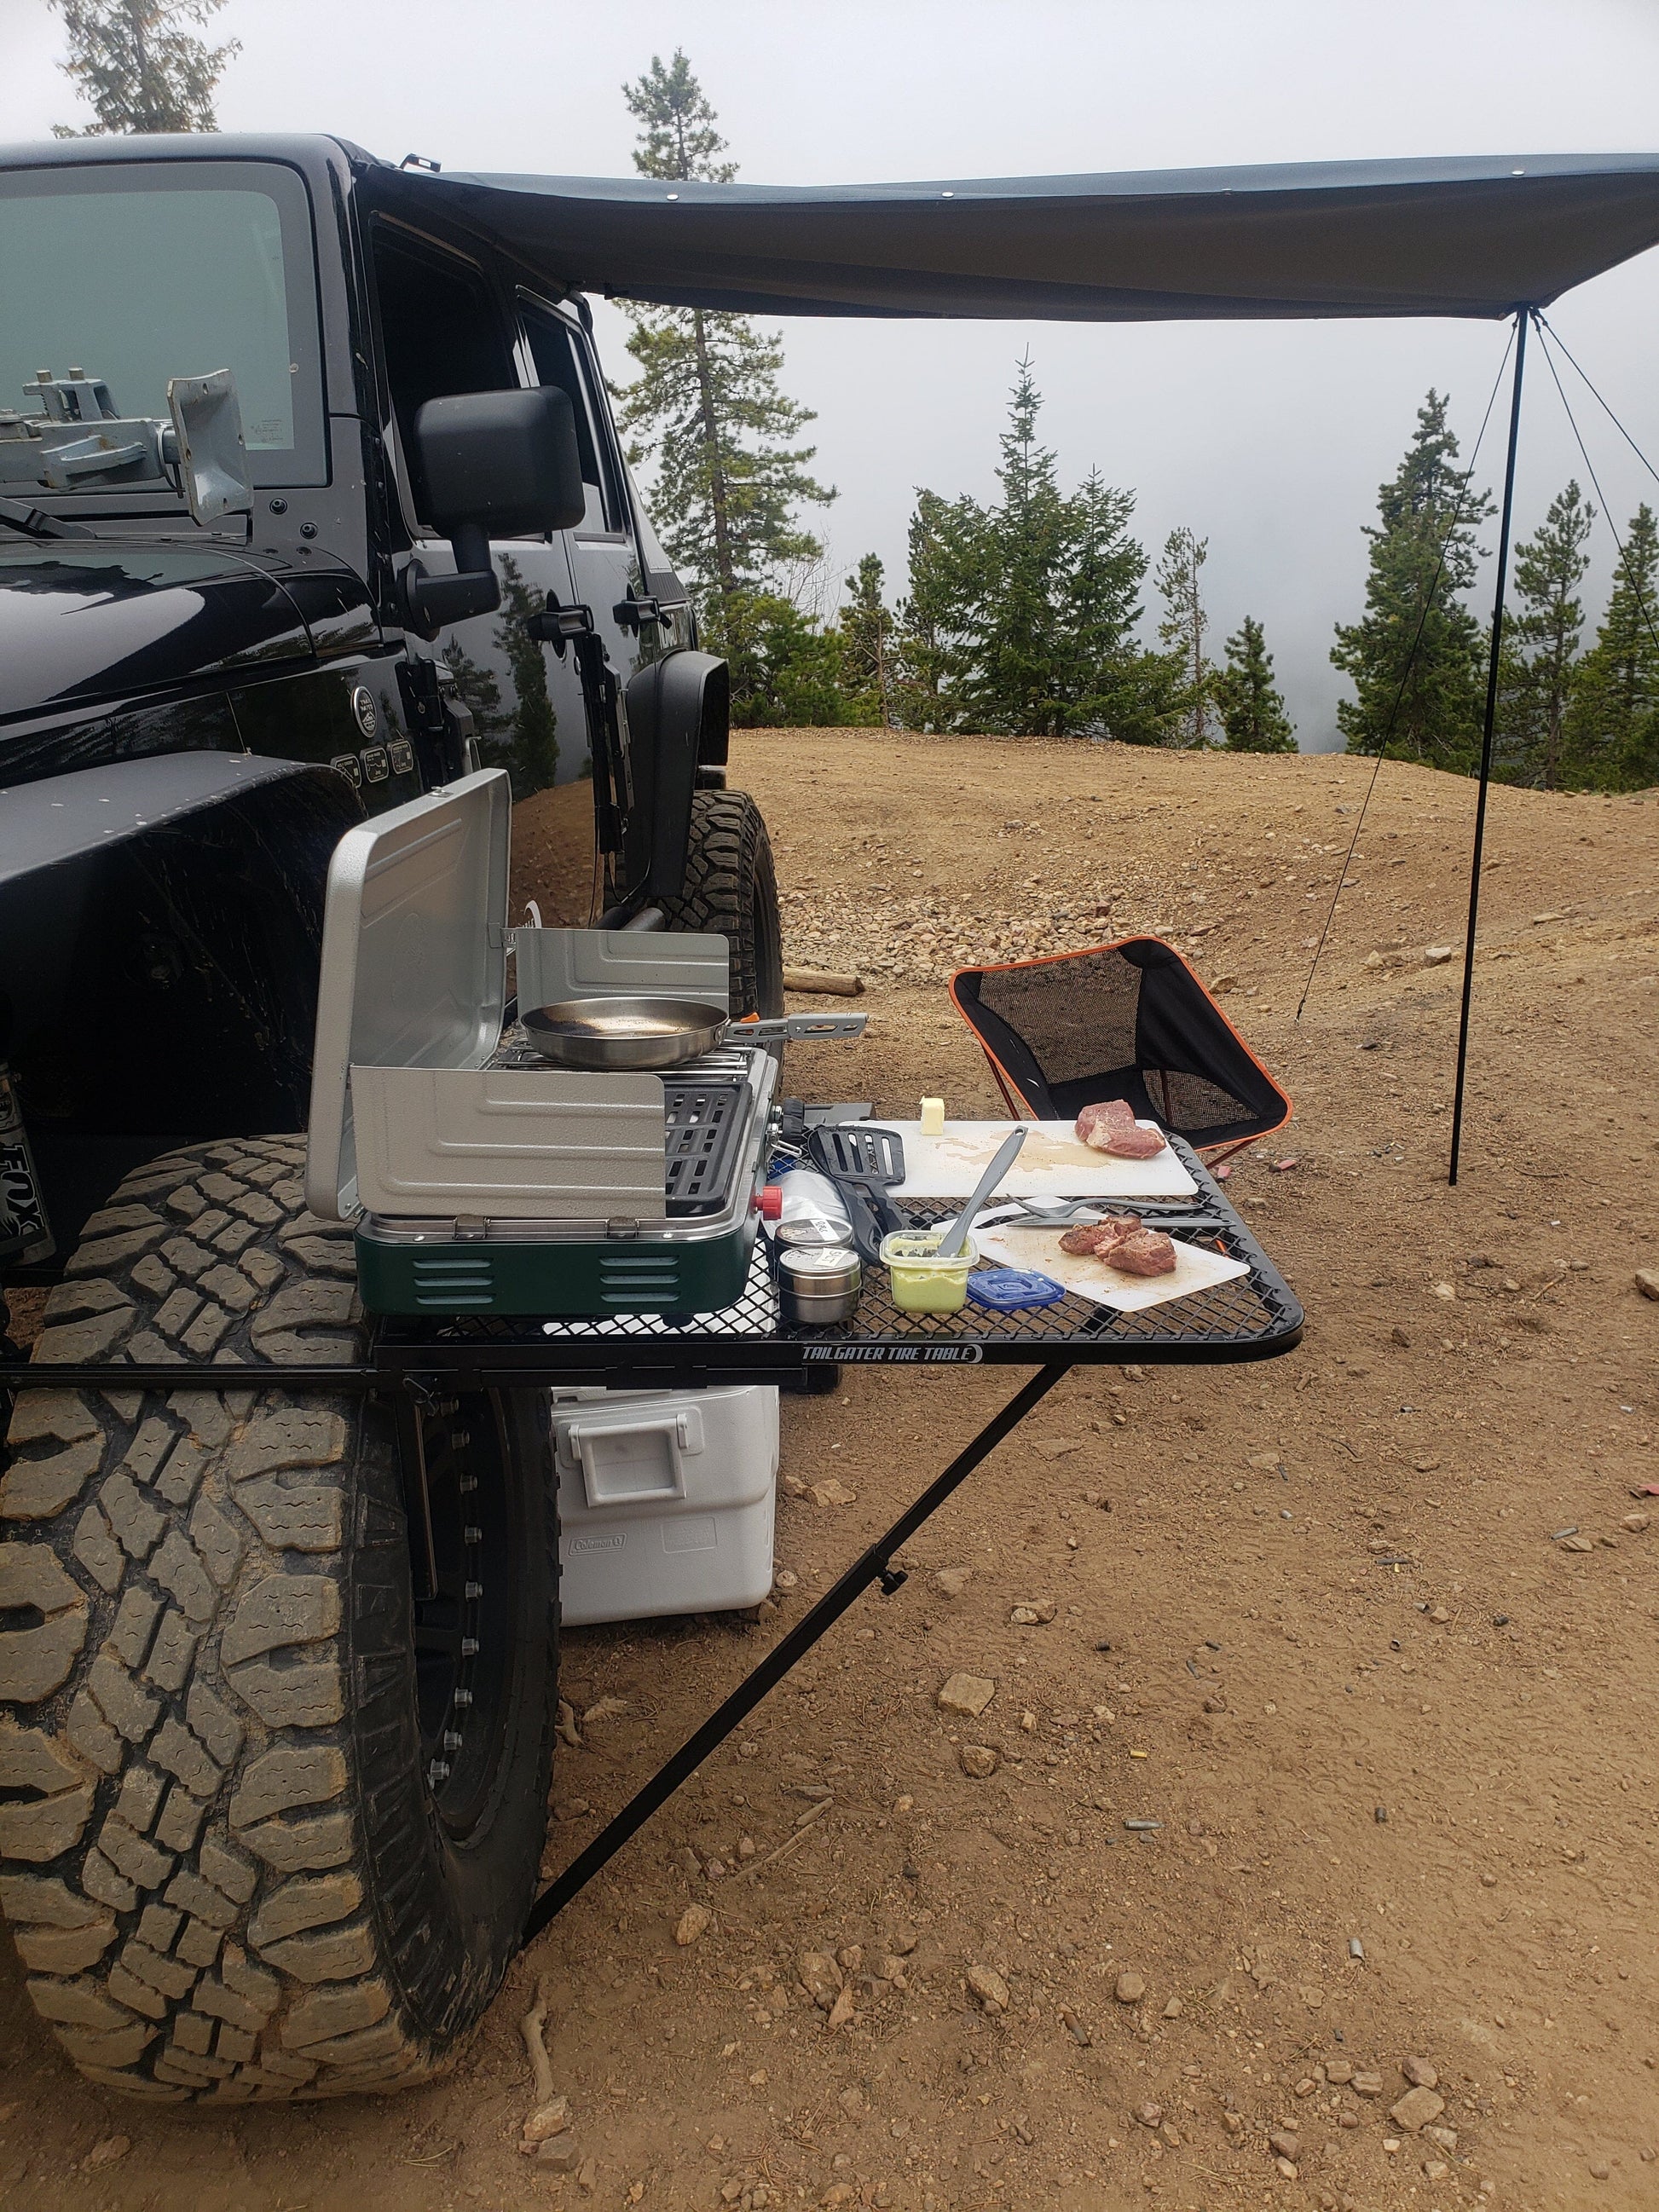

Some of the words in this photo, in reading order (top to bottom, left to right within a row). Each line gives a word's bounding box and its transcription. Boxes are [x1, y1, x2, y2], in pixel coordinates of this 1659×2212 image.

[0, 1145, 44, 1236] FOX
[802, 1346, 886, 1360] TAILGATER
[887, 1347, 922, 1360] TIRE
[924, 1347, 973, 1360] TABLE
[575, 1538, 612, 1551] Coleman
